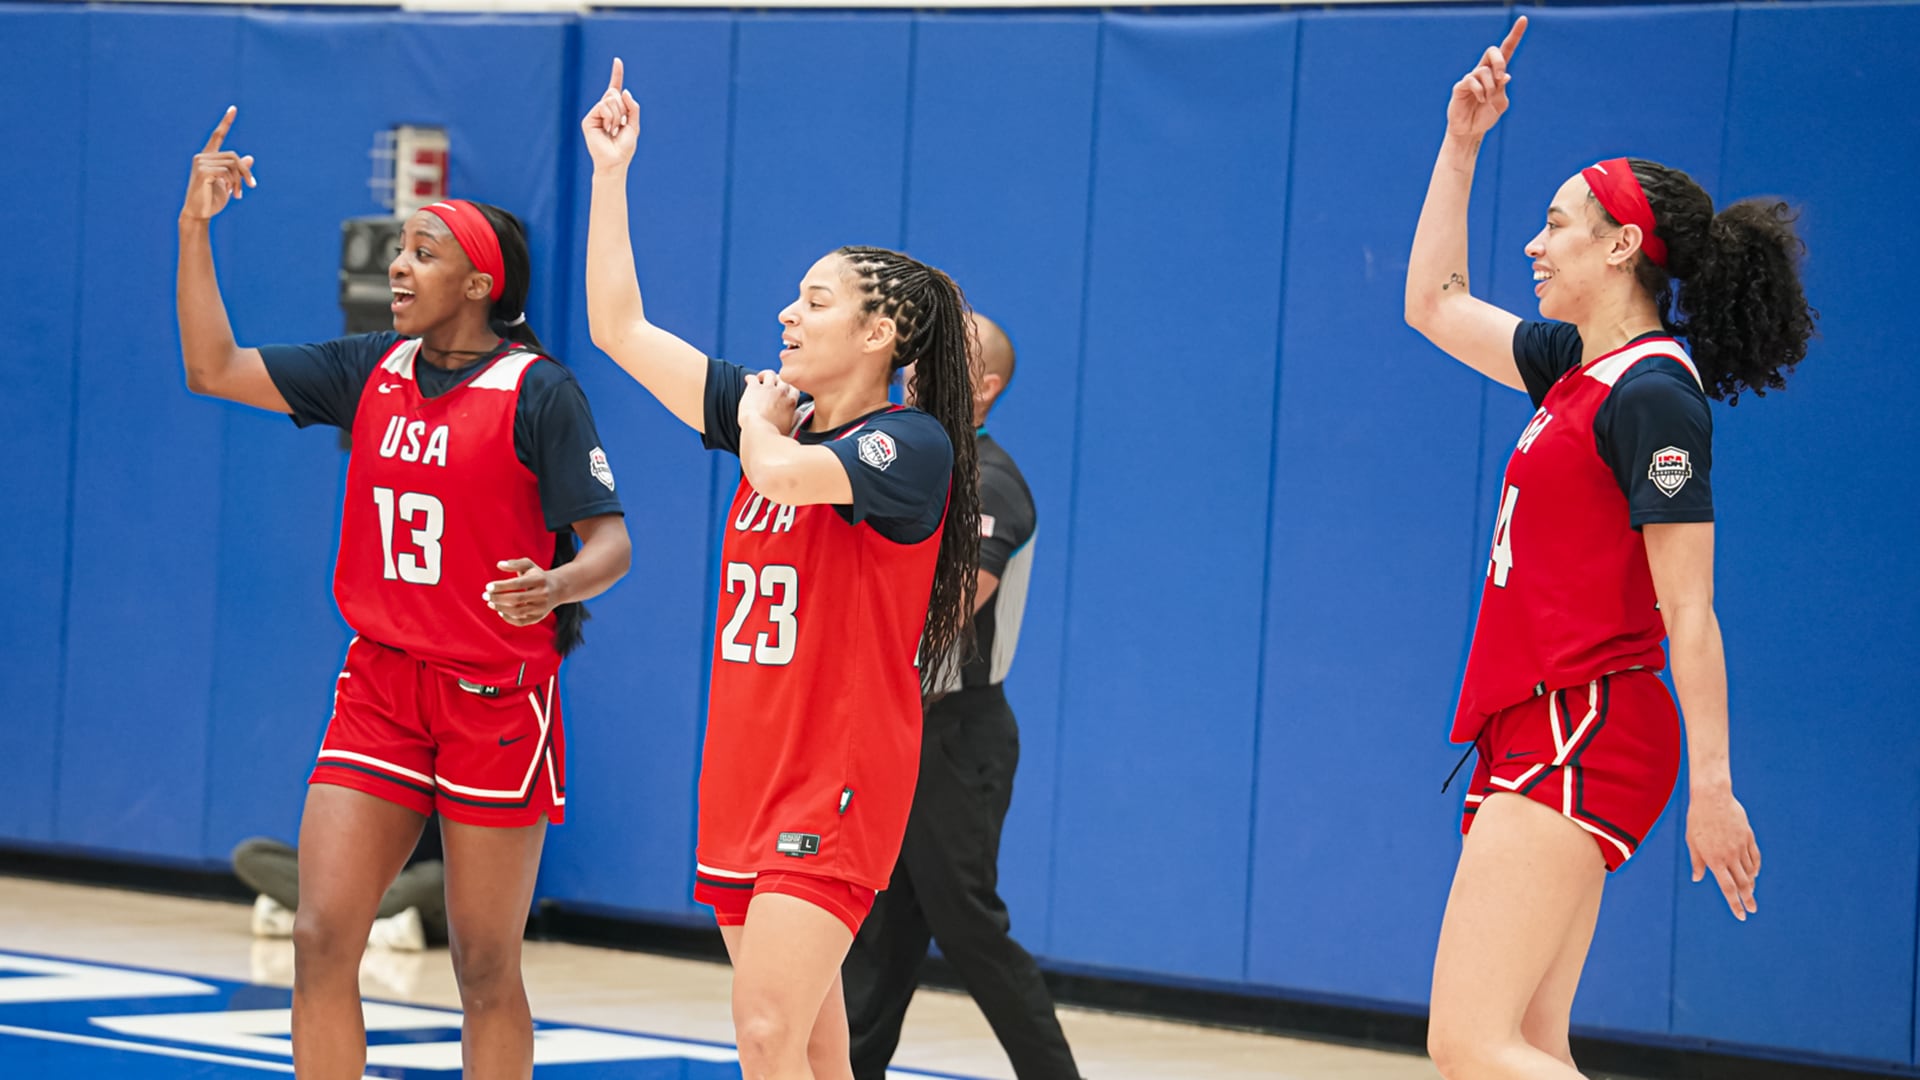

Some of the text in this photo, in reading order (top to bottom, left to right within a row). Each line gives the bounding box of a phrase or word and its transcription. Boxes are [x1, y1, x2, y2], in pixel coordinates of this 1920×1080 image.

[380, 416, 449, 467] USA
[1658, 455, 1683, 467] USA
[372, 487, 444, 586] 13
[721, 562, 799, 665] 23
[805, 838, 812, 849] L
